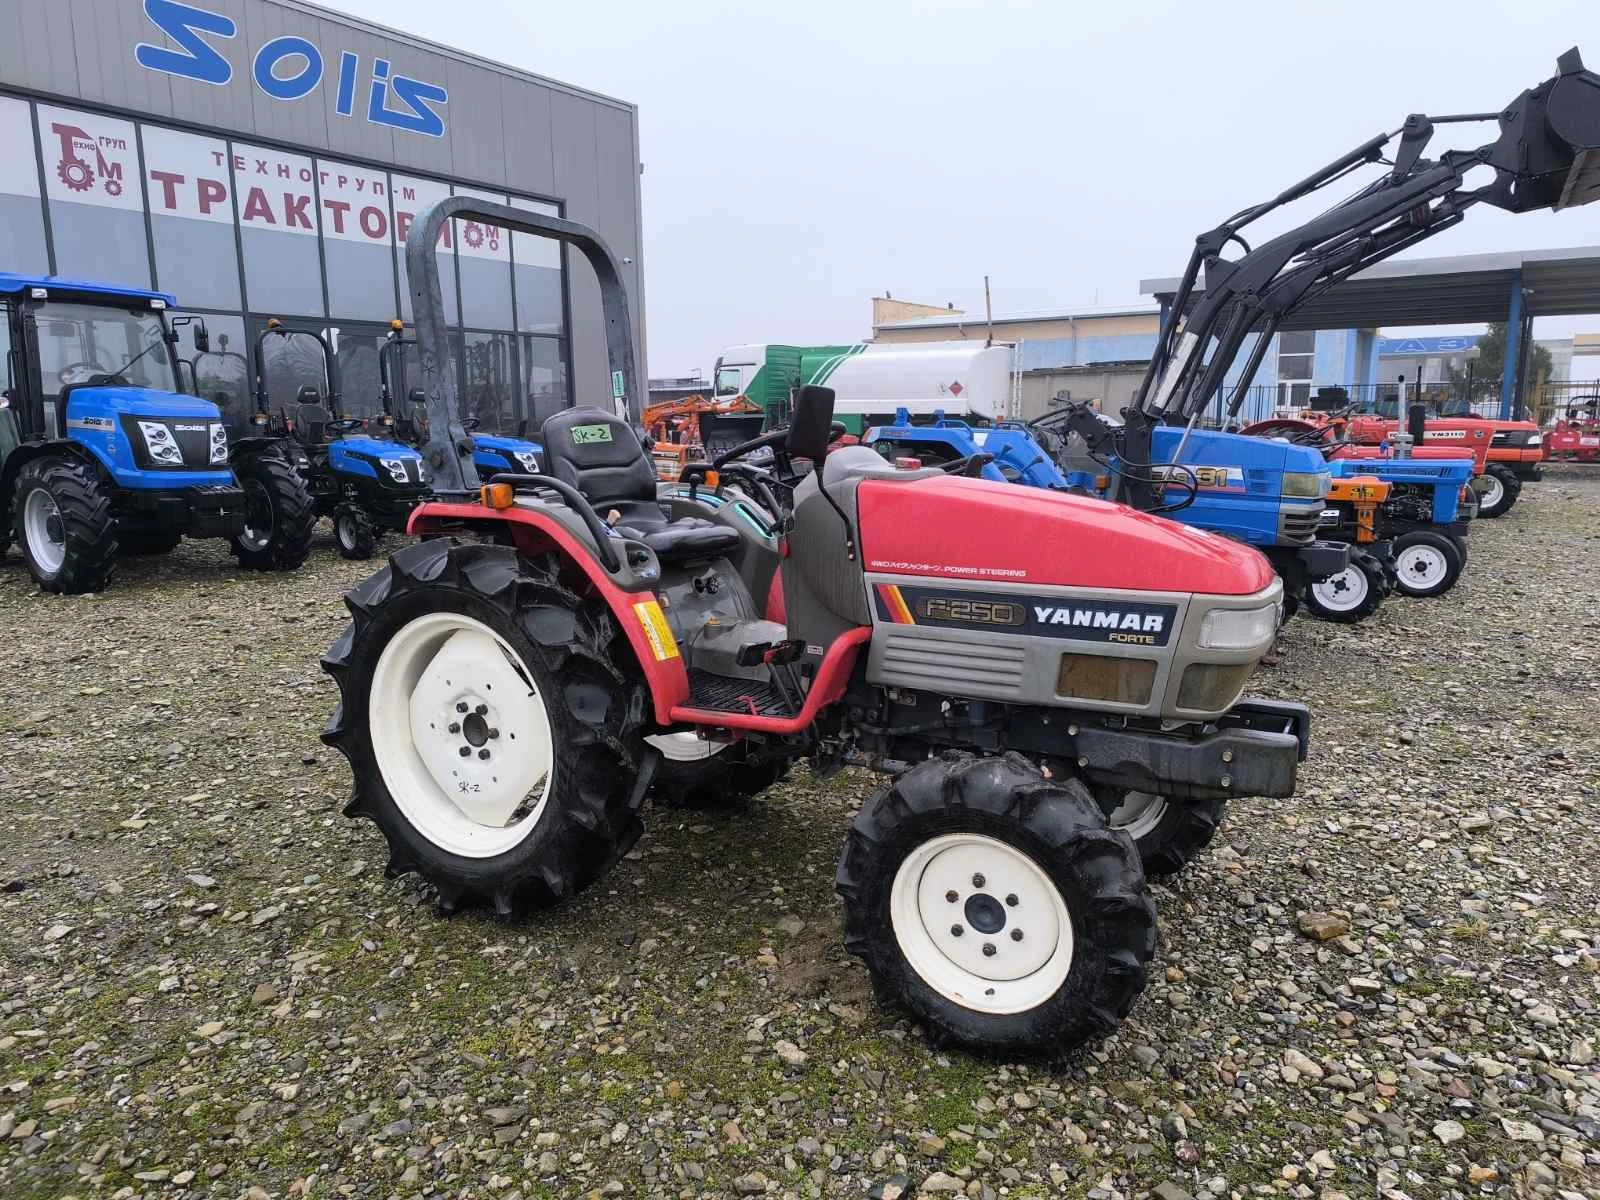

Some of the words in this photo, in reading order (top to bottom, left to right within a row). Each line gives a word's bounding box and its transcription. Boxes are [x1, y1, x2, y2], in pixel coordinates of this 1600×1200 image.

[944, 566, 978, 574] POWER
[979, 568, 1027, 577] STEERING
[1033, 606, 1164, 632] YANMAR
[1108, 632, 1156, 645] FORTE
